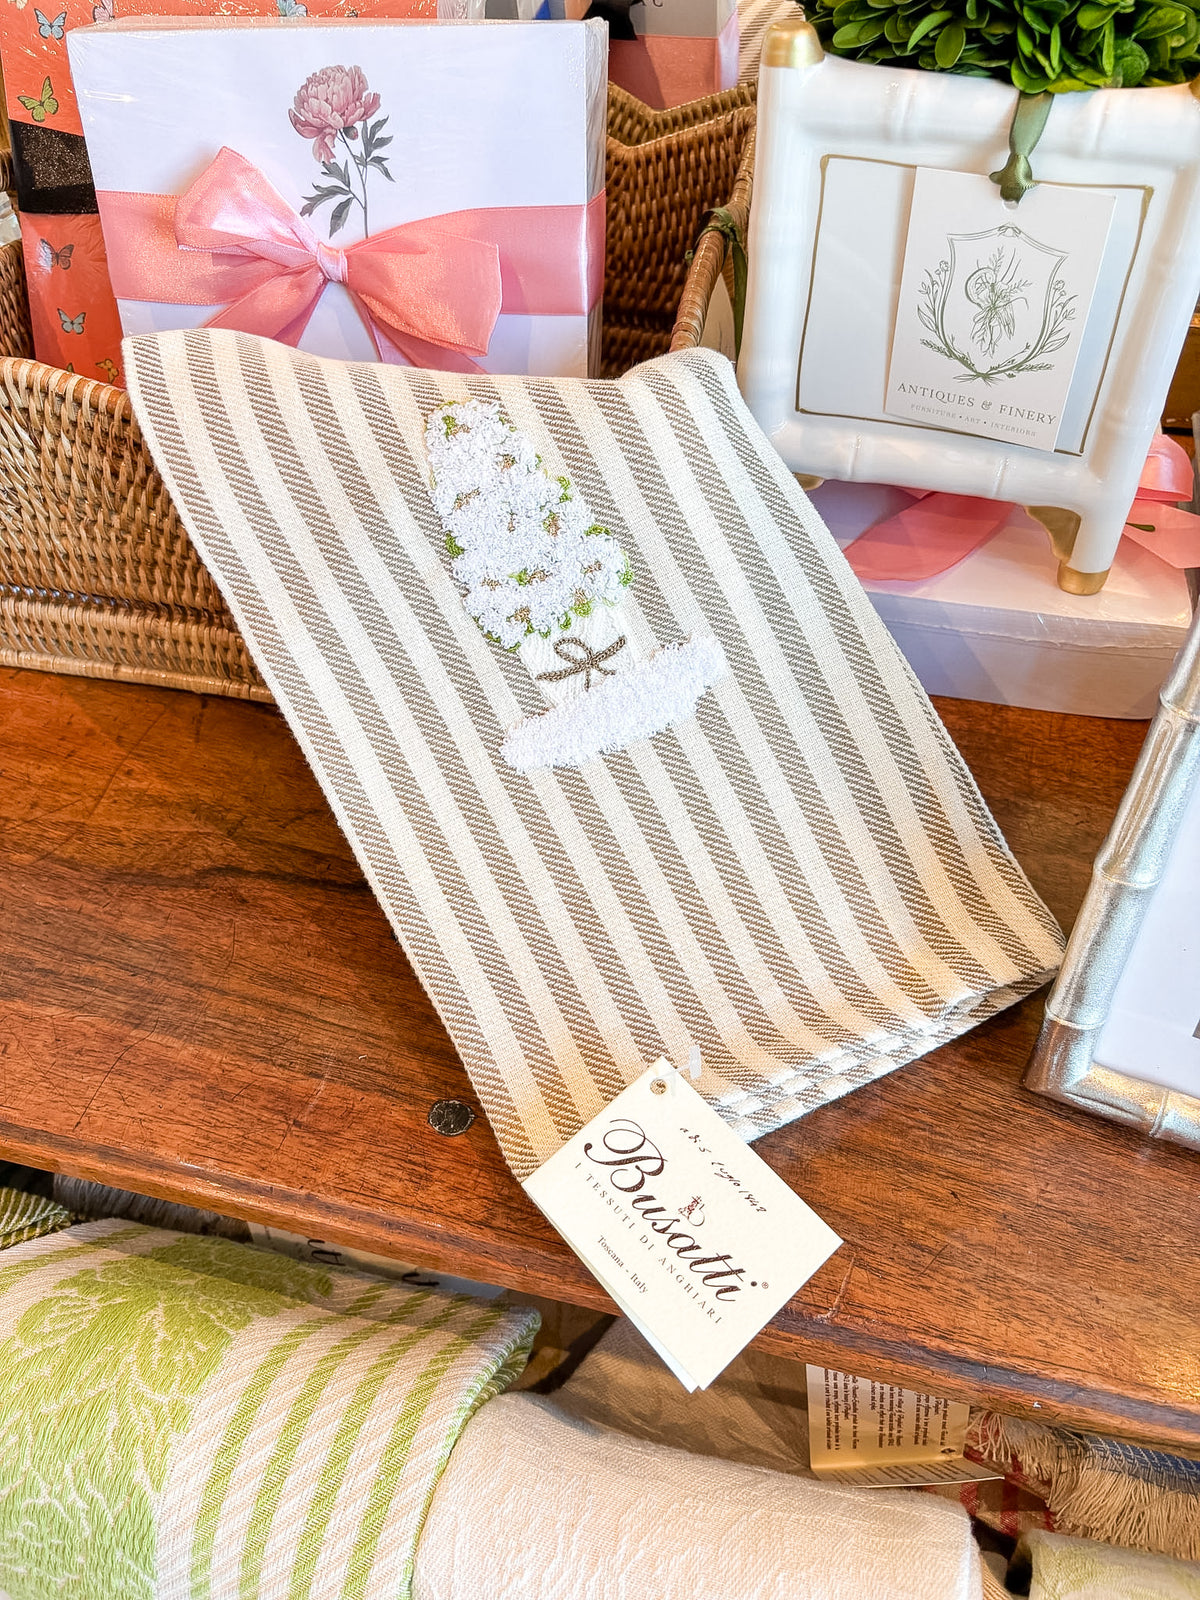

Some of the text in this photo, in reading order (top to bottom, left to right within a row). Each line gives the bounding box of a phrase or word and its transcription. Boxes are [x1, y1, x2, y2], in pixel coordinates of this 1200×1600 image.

[897, 382, 1057, 425] ANTIQUES & FINERY
[910, 403, 1036, 437] FURNITURE ART INTERIORS
[583, 1118, 758, 1302] Busatti
[586, 1173, 635, 1229] TESSUTI
[640, 1234, 655, 1251] DI
[658, 1257, 722, 1324] ANGHIARI
[597, 1235, 625, 1268] Toscana
[630, 1273, 648, 1294] Italy
